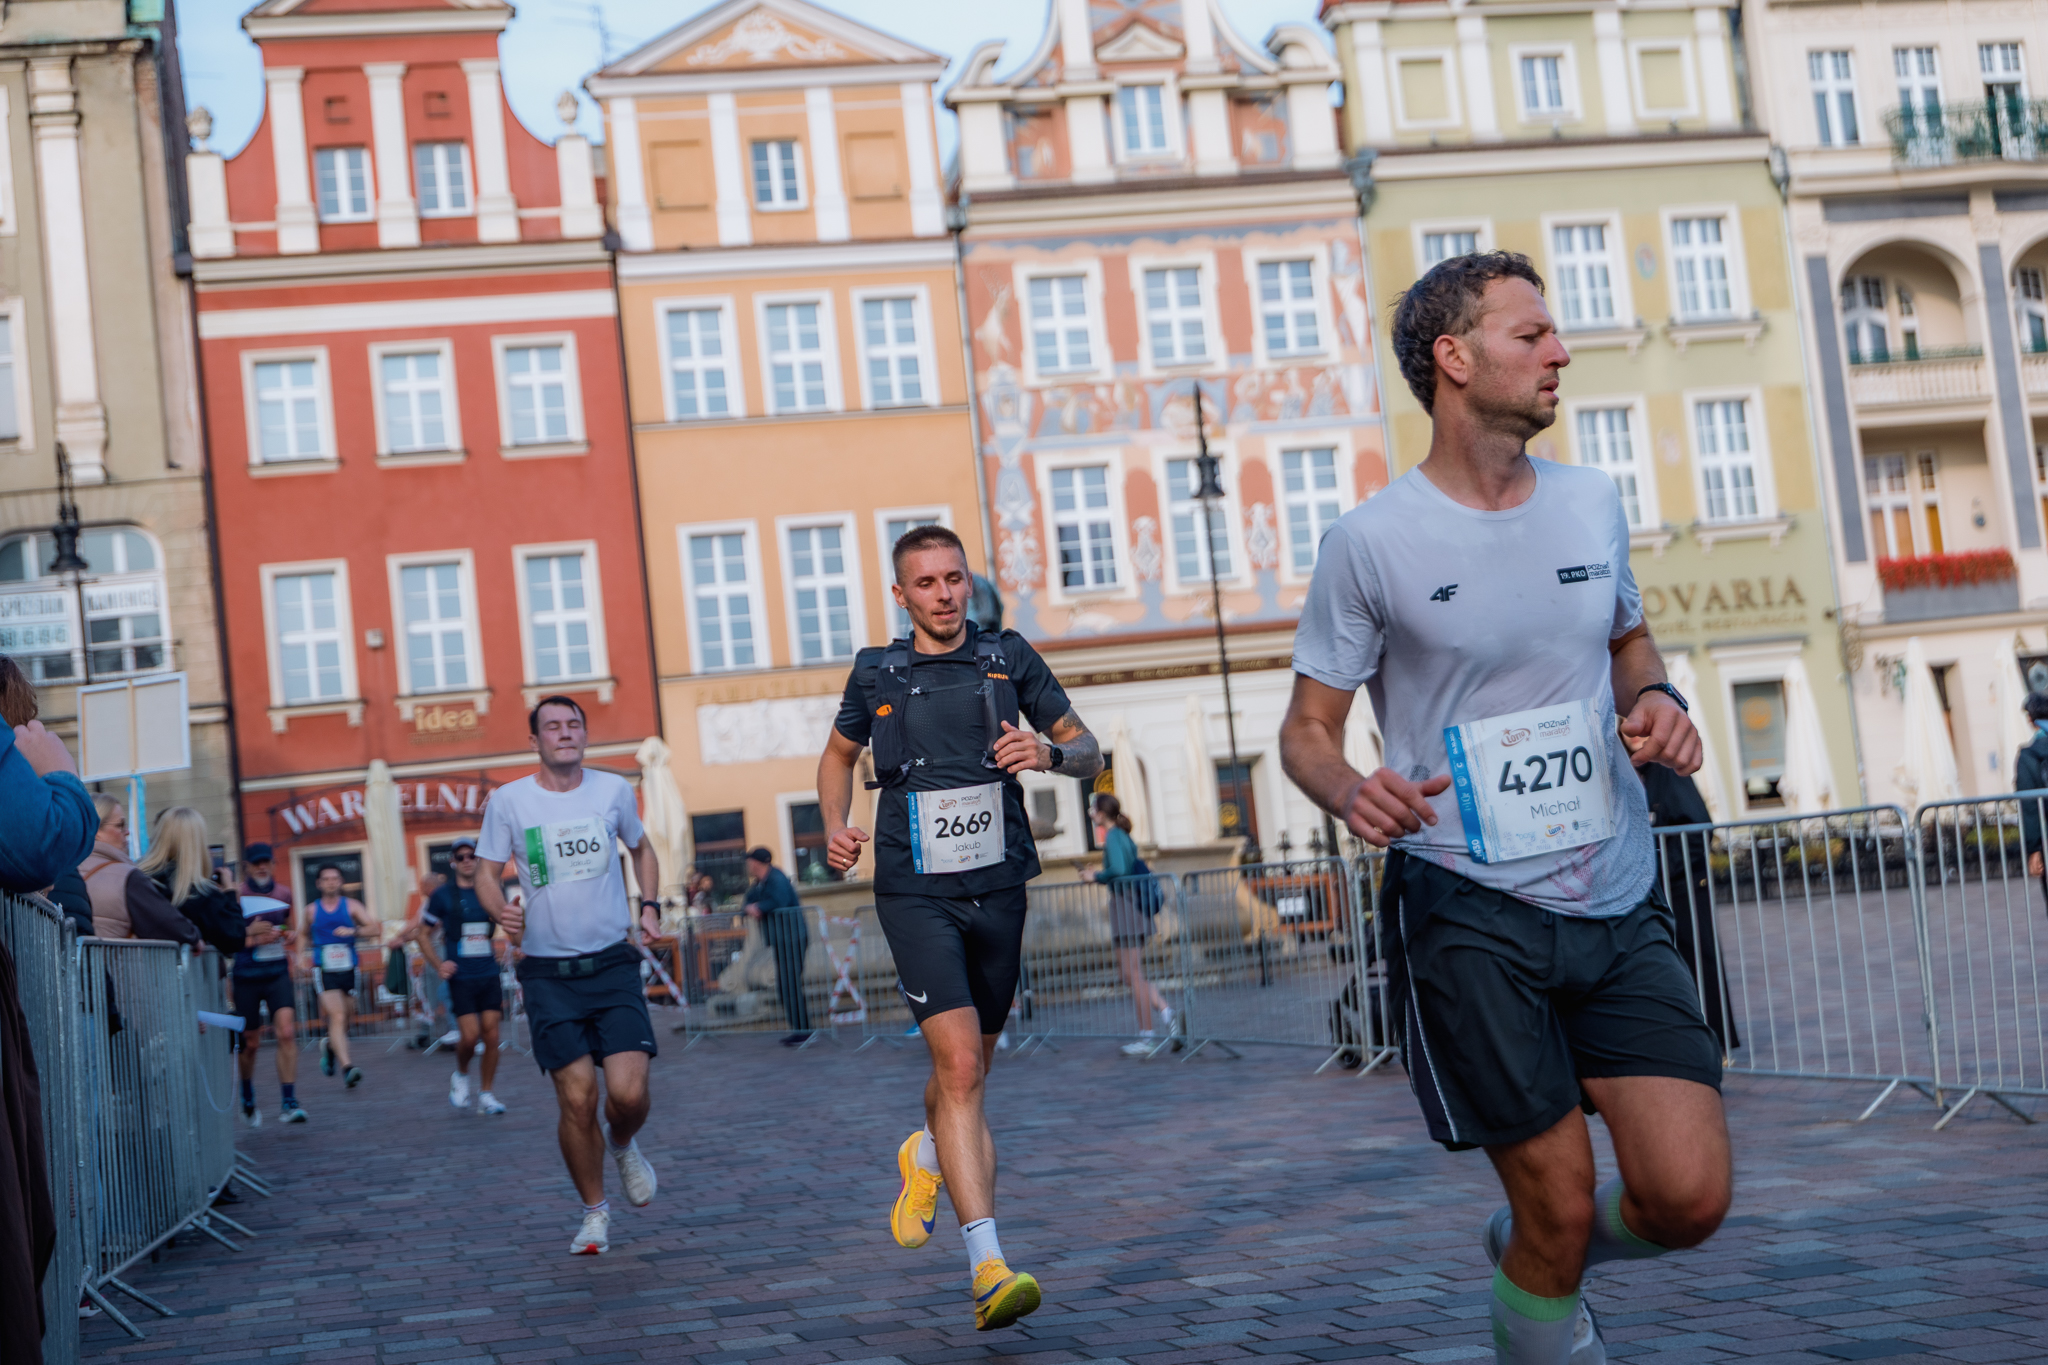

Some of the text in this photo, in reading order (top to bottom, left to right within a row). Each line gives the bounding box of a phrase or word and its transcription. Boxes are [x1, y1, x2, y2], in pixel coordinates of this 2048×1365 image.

[1571, 569, 1586, 579] PKO
[1588, 569, 1611, 577] maraton
[1429, 583, 1459, 602] 4F
[1641, 573, 1807, 619] OVARIA
[414, 705, 478, 732] idea
[1498, 745, 1593, 796] 4270
[279, 782, 497, 836] WARELNI
[1530, 796, 1582, 819] Michał
[934, 811, 992, 839] 2669
[554, 836, 601, 858] 1306
[952, 841, 982, 853] Jakub
